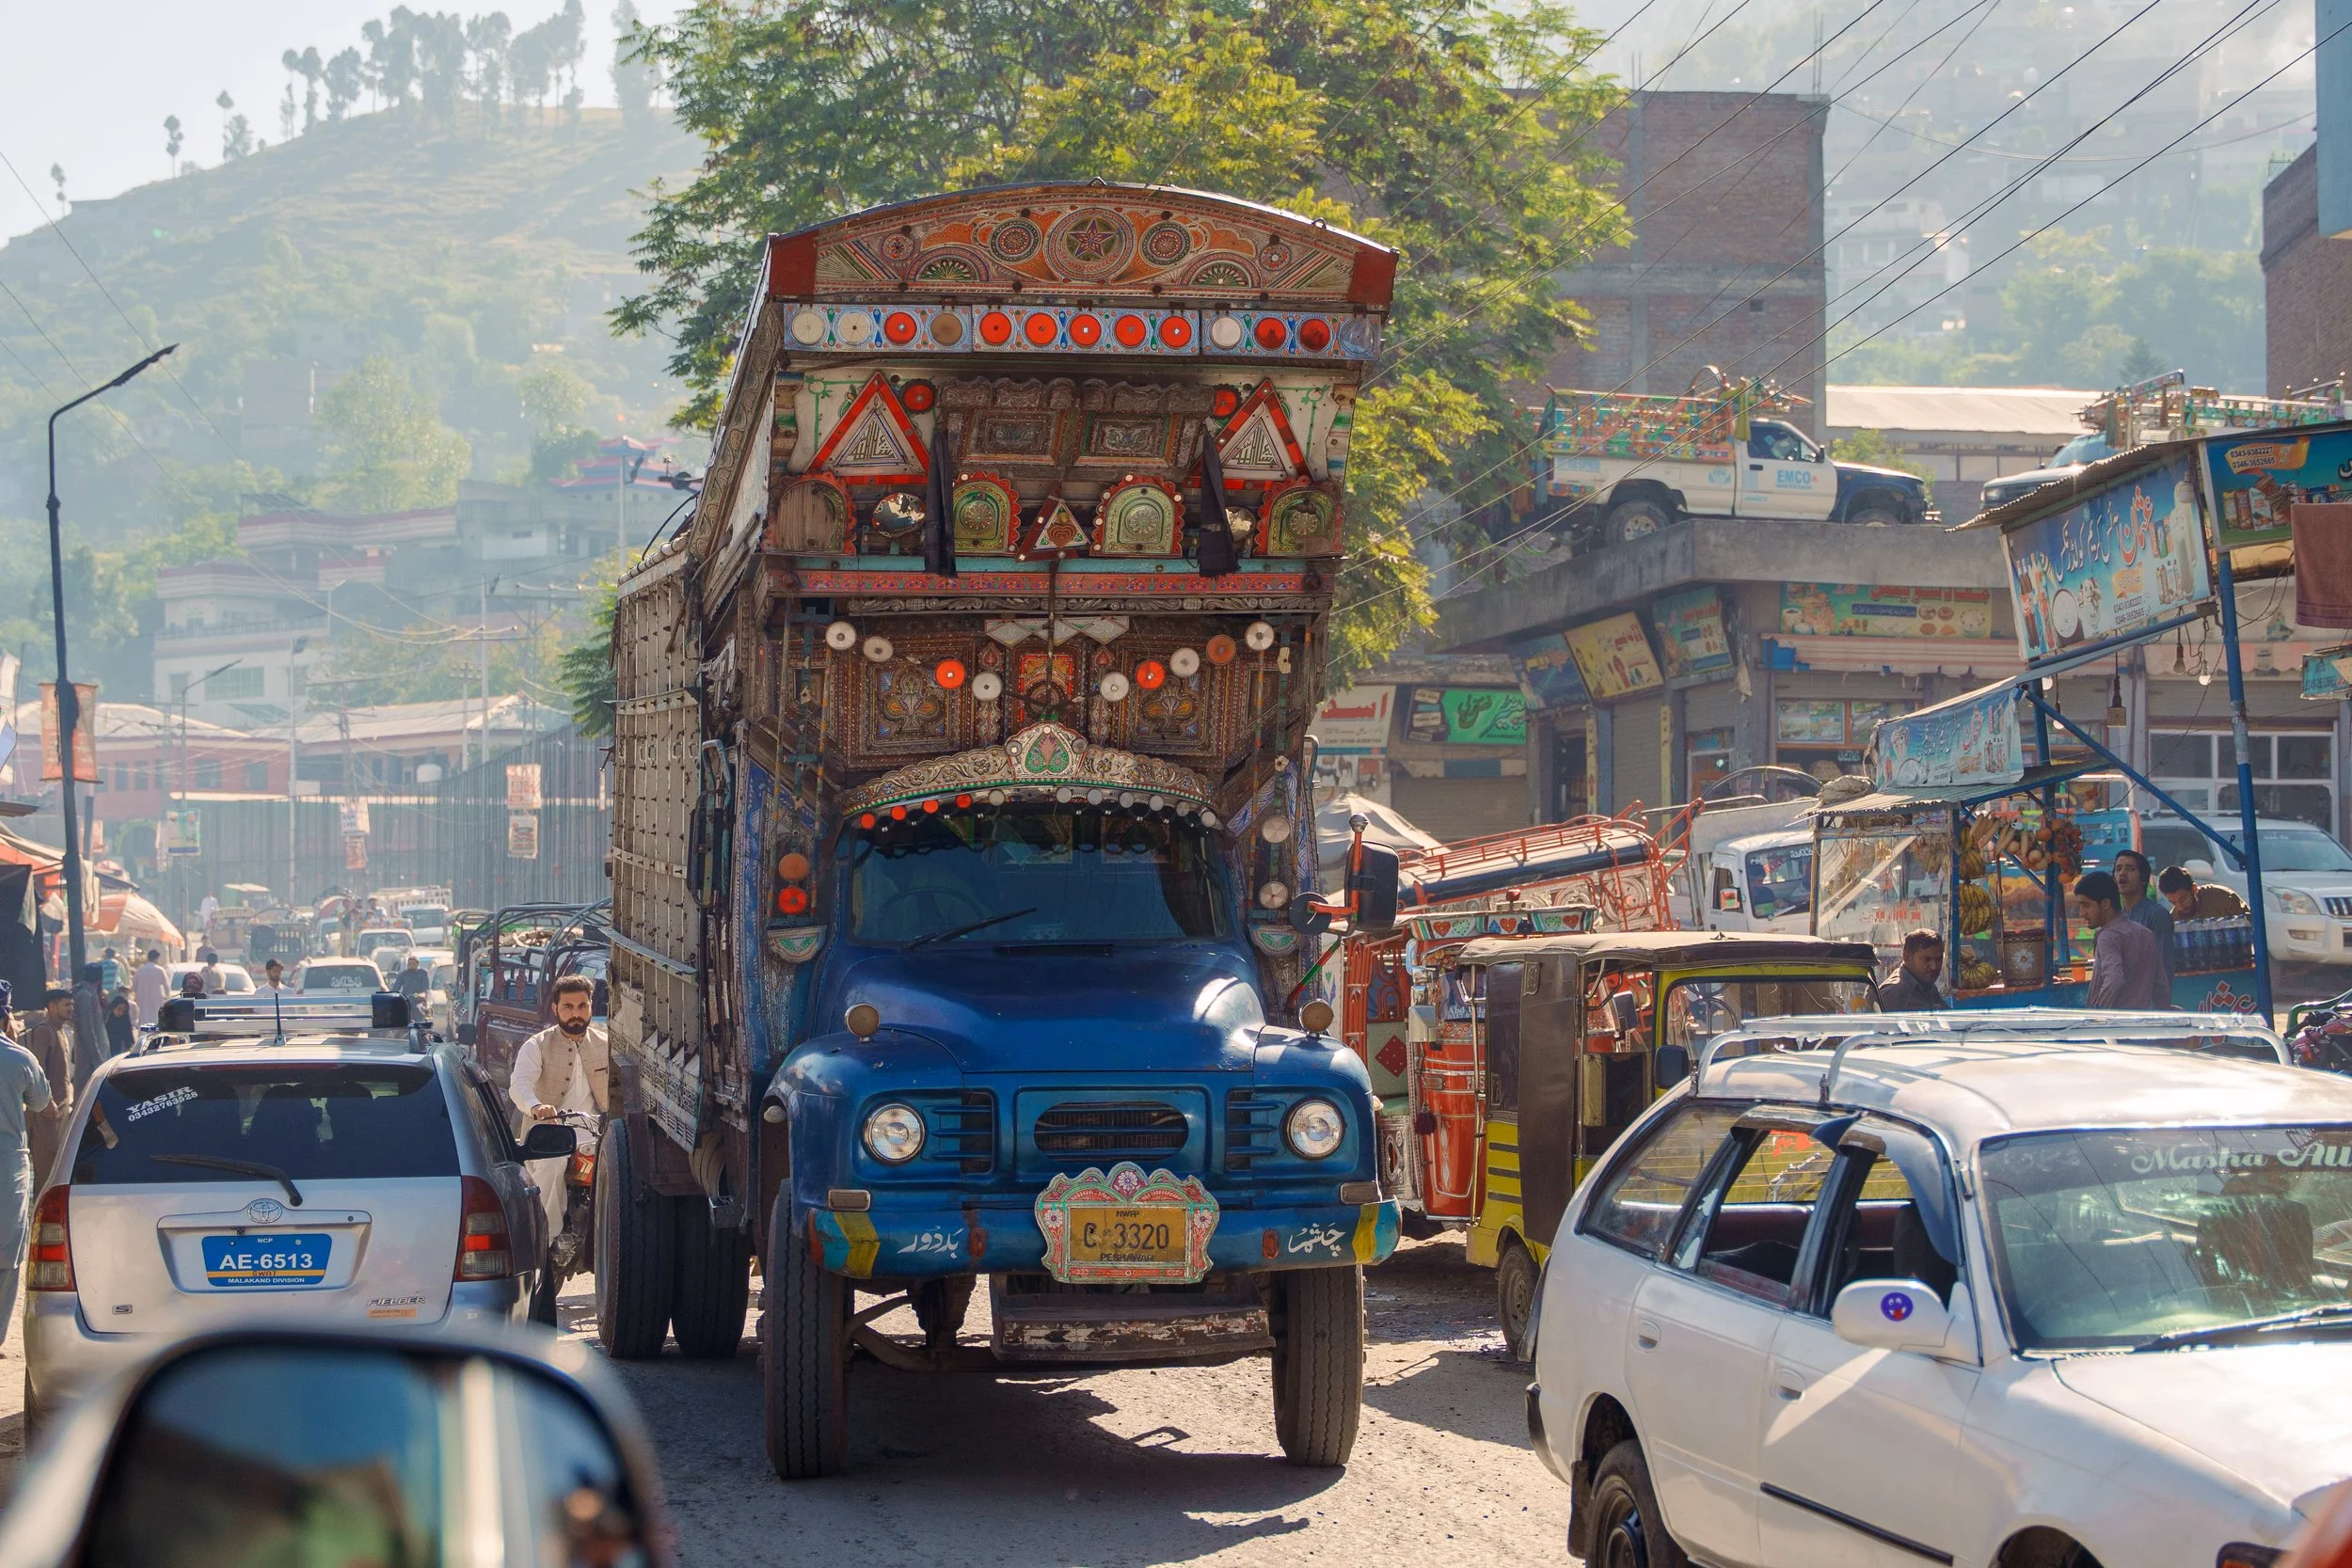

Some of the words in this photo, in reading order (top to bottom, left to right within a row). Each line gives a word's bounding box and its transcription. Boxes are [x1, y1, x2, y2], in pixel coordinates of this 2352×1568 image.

[1776, 469, 1811, 483] EMCO
[126, 1085, 194, 1114] YASIR
[128, 1091, 199, 1122] 03432763528
[2131, 1146, 2268, 1174] Masha
[218, 1253, 313, 1270] AE-6513
[367, 1295, 426, 1307] FIELDER
